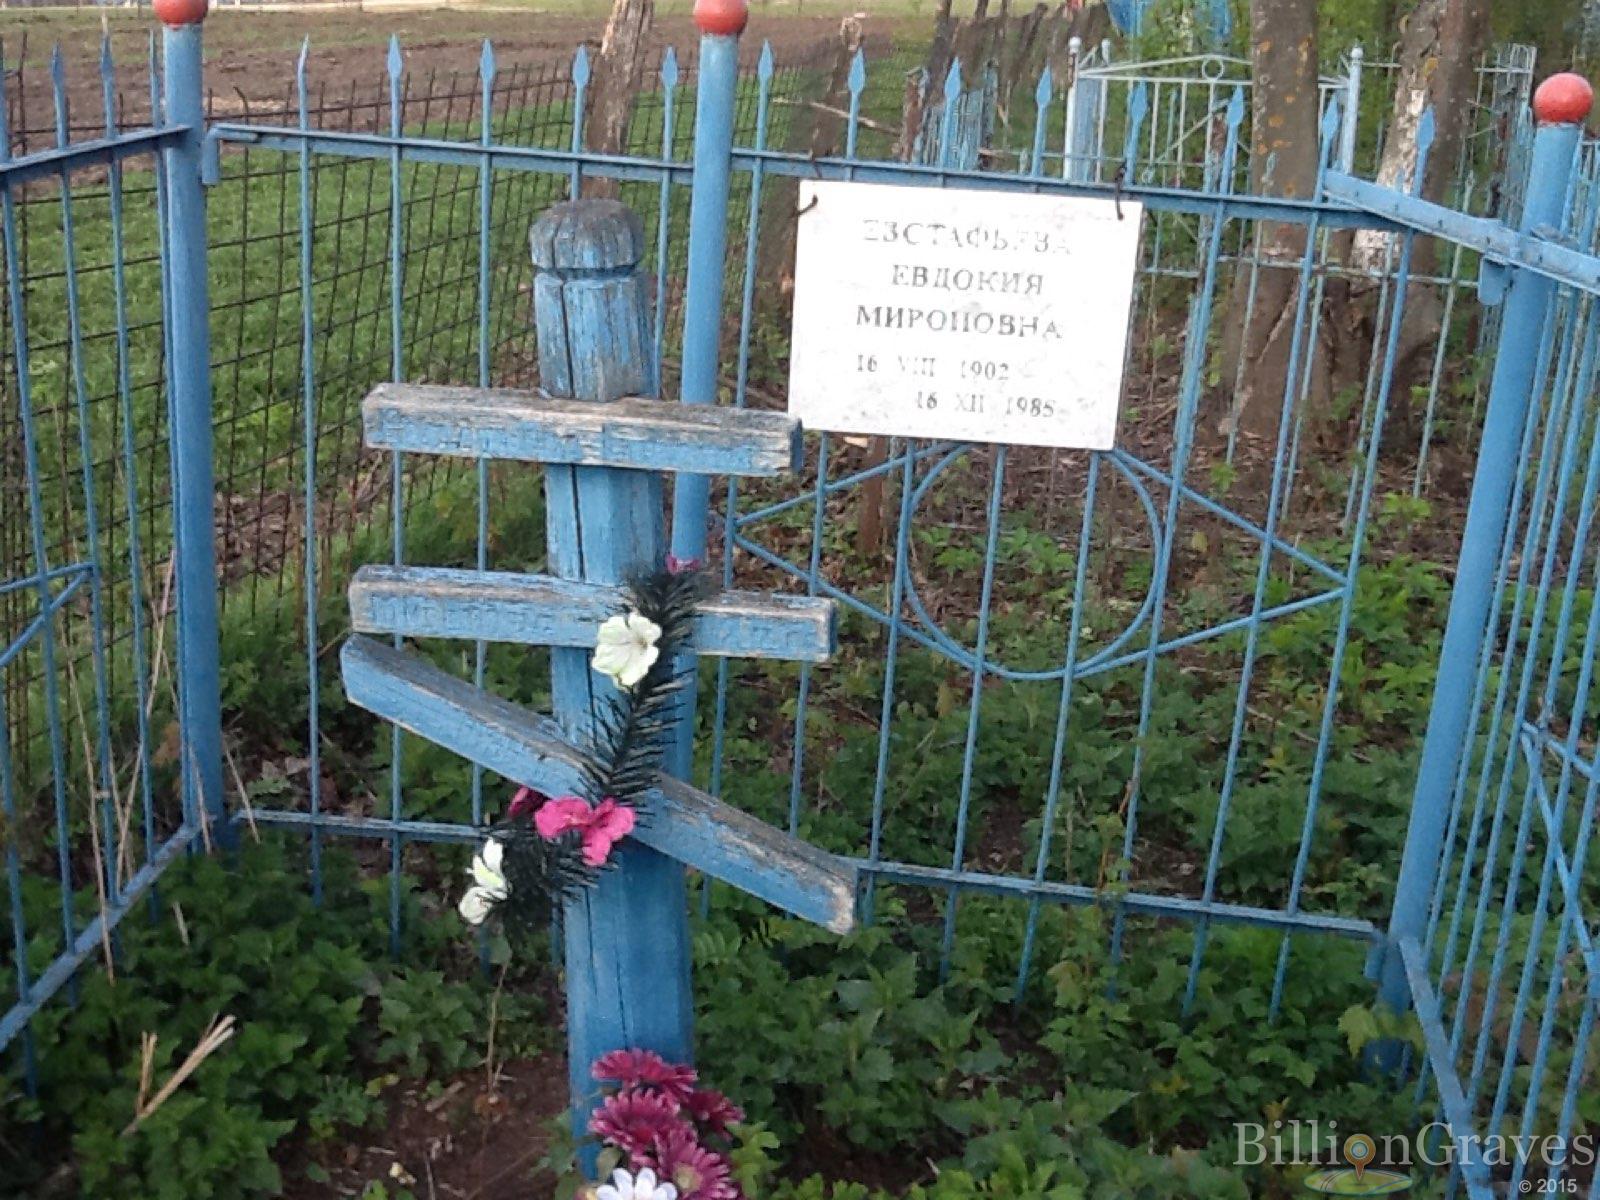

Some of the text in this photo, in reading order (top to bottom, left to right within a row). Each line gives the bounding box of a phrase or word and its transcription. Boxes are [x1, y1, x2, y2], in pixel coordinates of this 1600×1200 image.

[892, 264, 1043, 295] ЕВДОКИЯ
[857, 354, 877, 372] 16
[961, 360, 1009, 381] 1902
[916, 391, 1055, 418] 16 XII 1985
